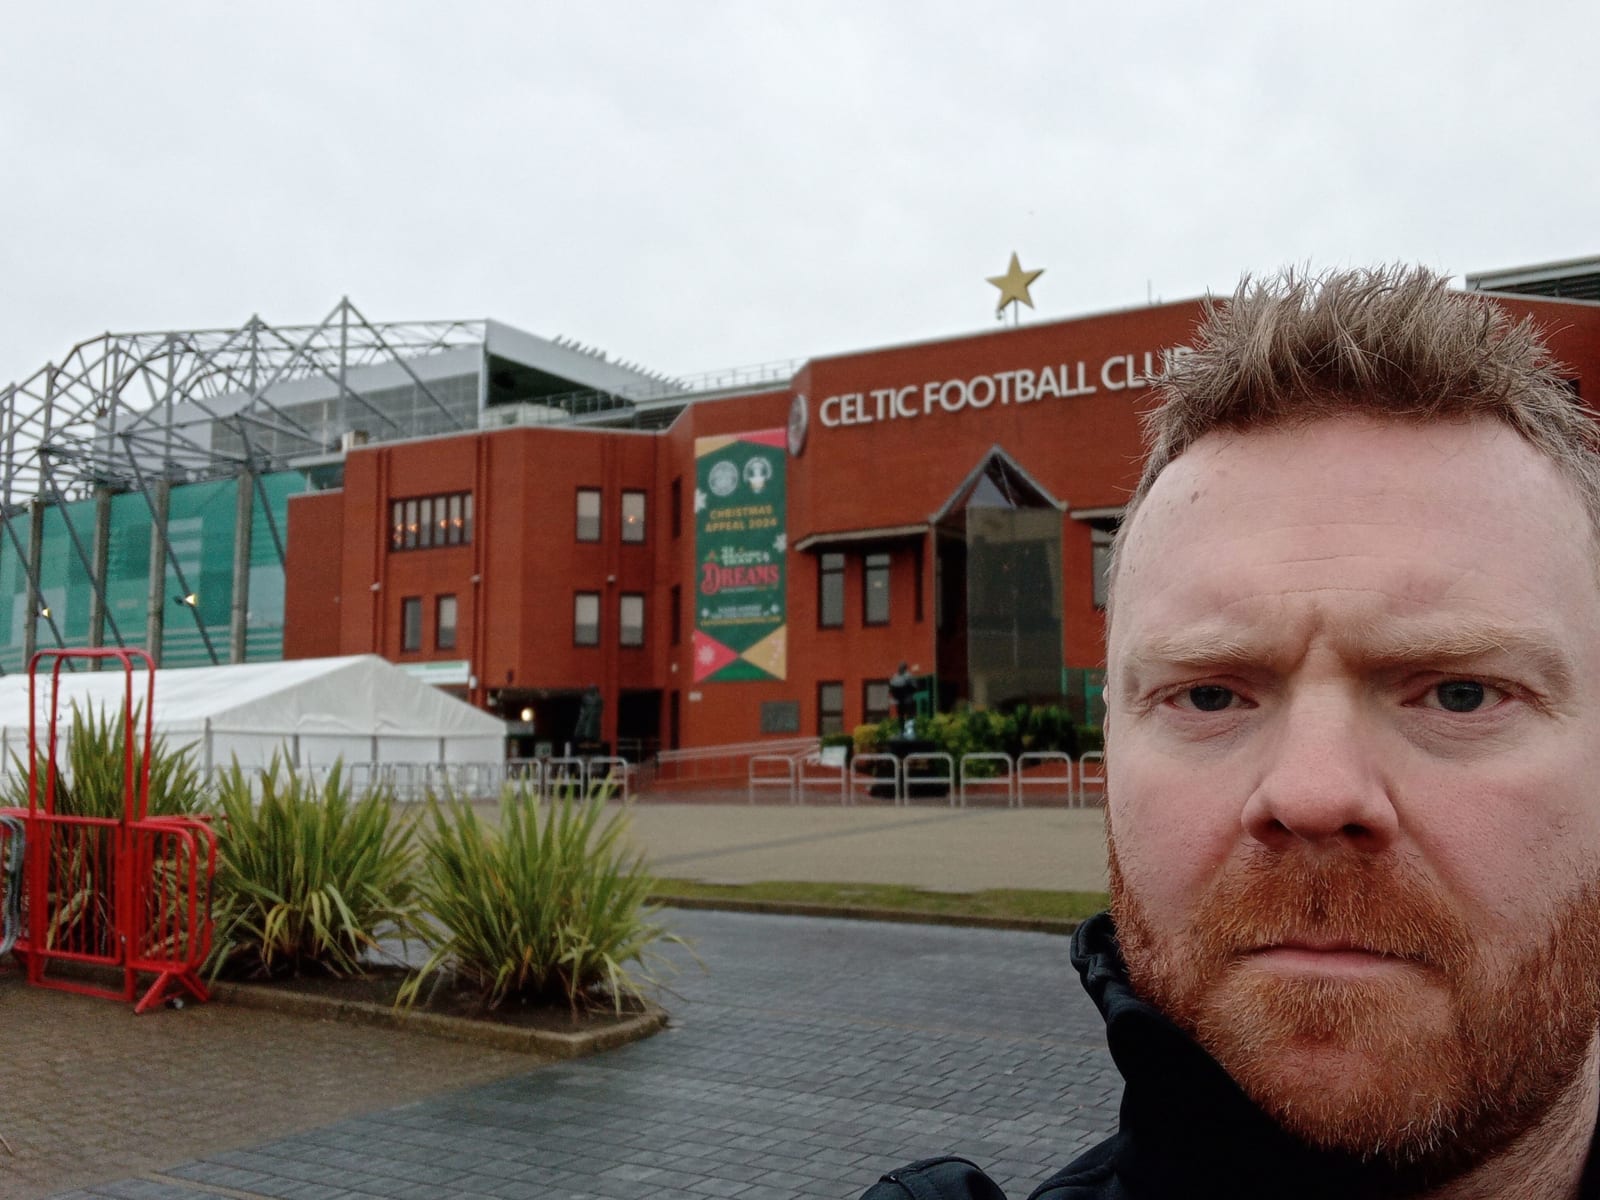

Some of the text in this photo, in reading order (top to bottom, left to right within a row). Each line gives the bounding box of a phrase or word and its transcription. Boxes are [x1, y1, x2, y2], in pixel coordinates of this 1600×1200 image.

[819, 385, 919, 427] CELTIC
[923, 361, 1097, 415] FOOTBALL
[710, 505, 772, 519] CHRISTMAS
[705, 517, 777, 532] APPEAL 2024
[701, 563, 779, 595] DREAMS
